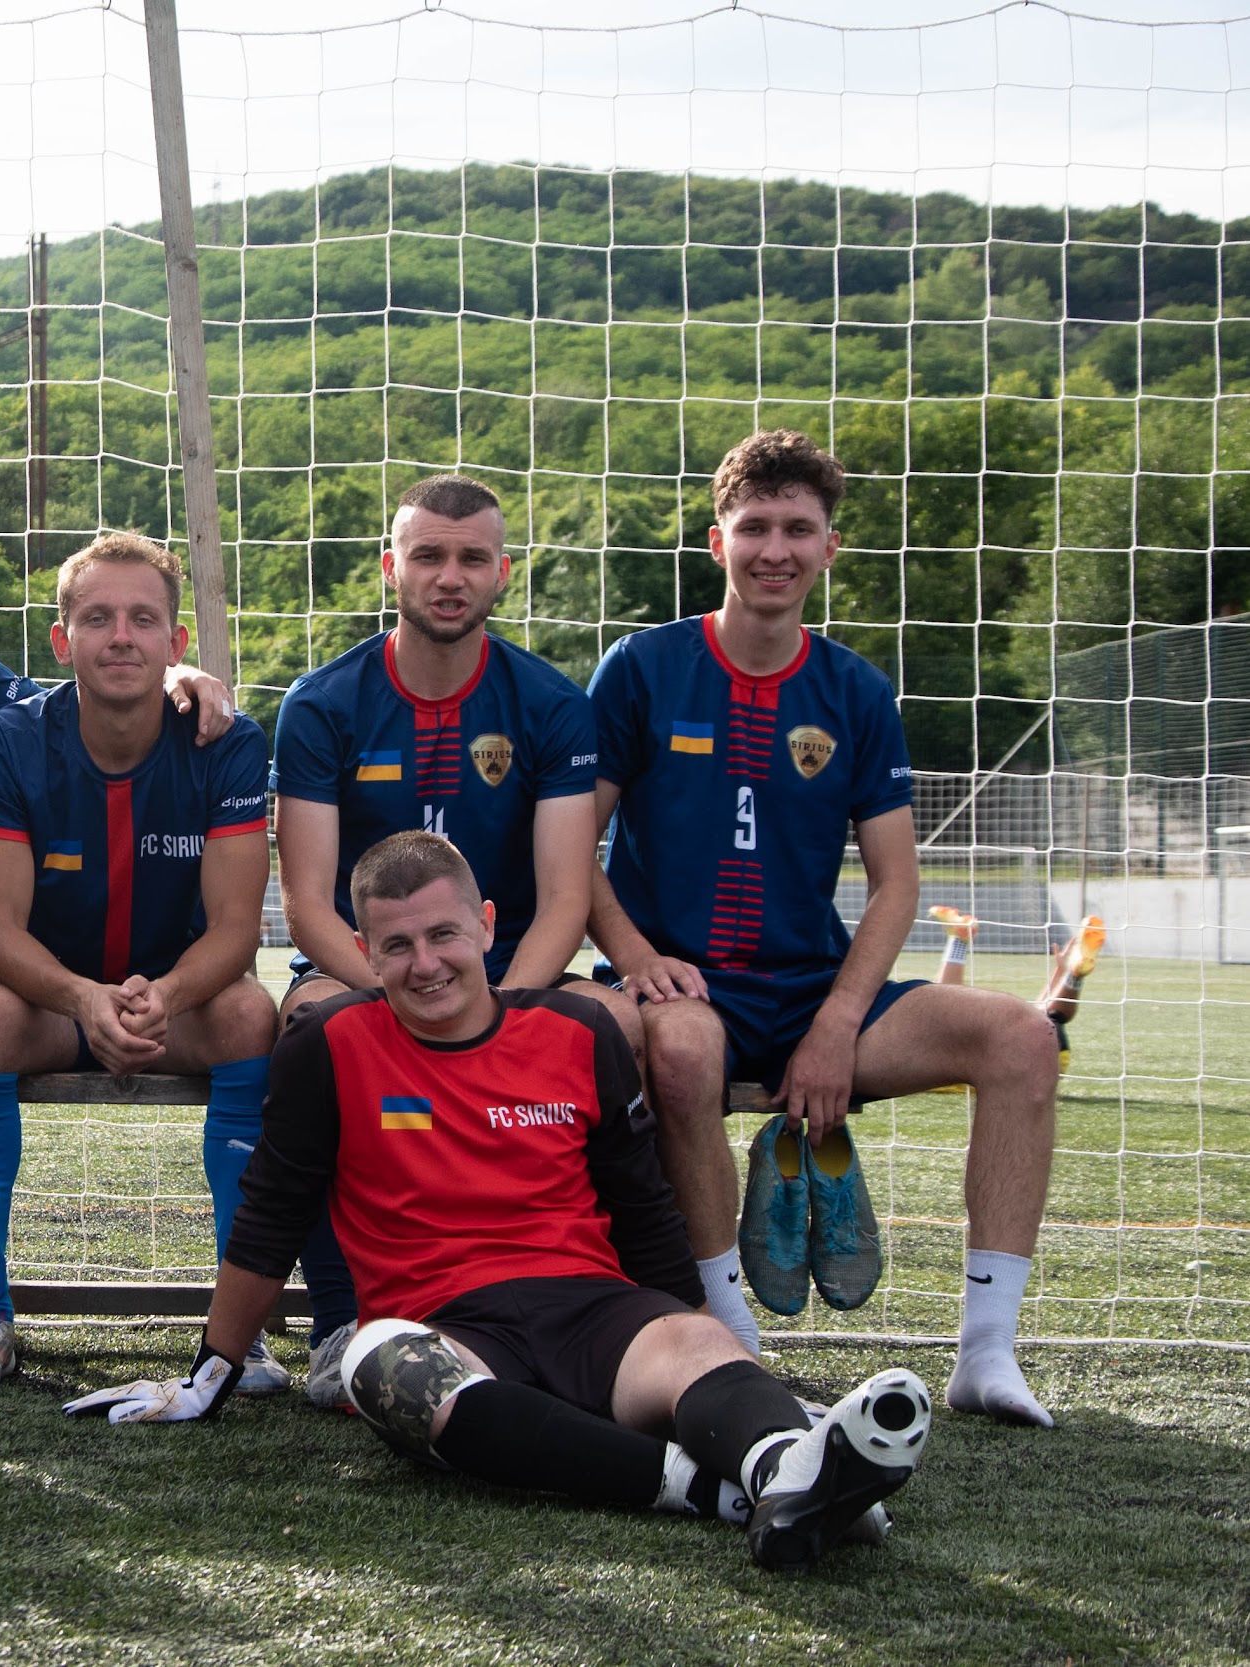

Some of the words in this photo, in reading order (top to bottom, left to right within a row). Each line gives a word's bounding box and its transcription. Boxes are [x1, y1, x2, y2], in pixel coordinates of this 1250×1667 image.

[473, 750, 512, 760] SIRIUS
[791, 740, 832, 754] SIRIUS
[221, 795, 264, 810] Вірим
[734, 785, 758, 851] 9
[140, 833, 159, 858] FC
[162, 833, 207, 858] SIRIU
[486, 1106, 513, 1129] FC
[514, 1102, 577, 1128] SIRIUS
